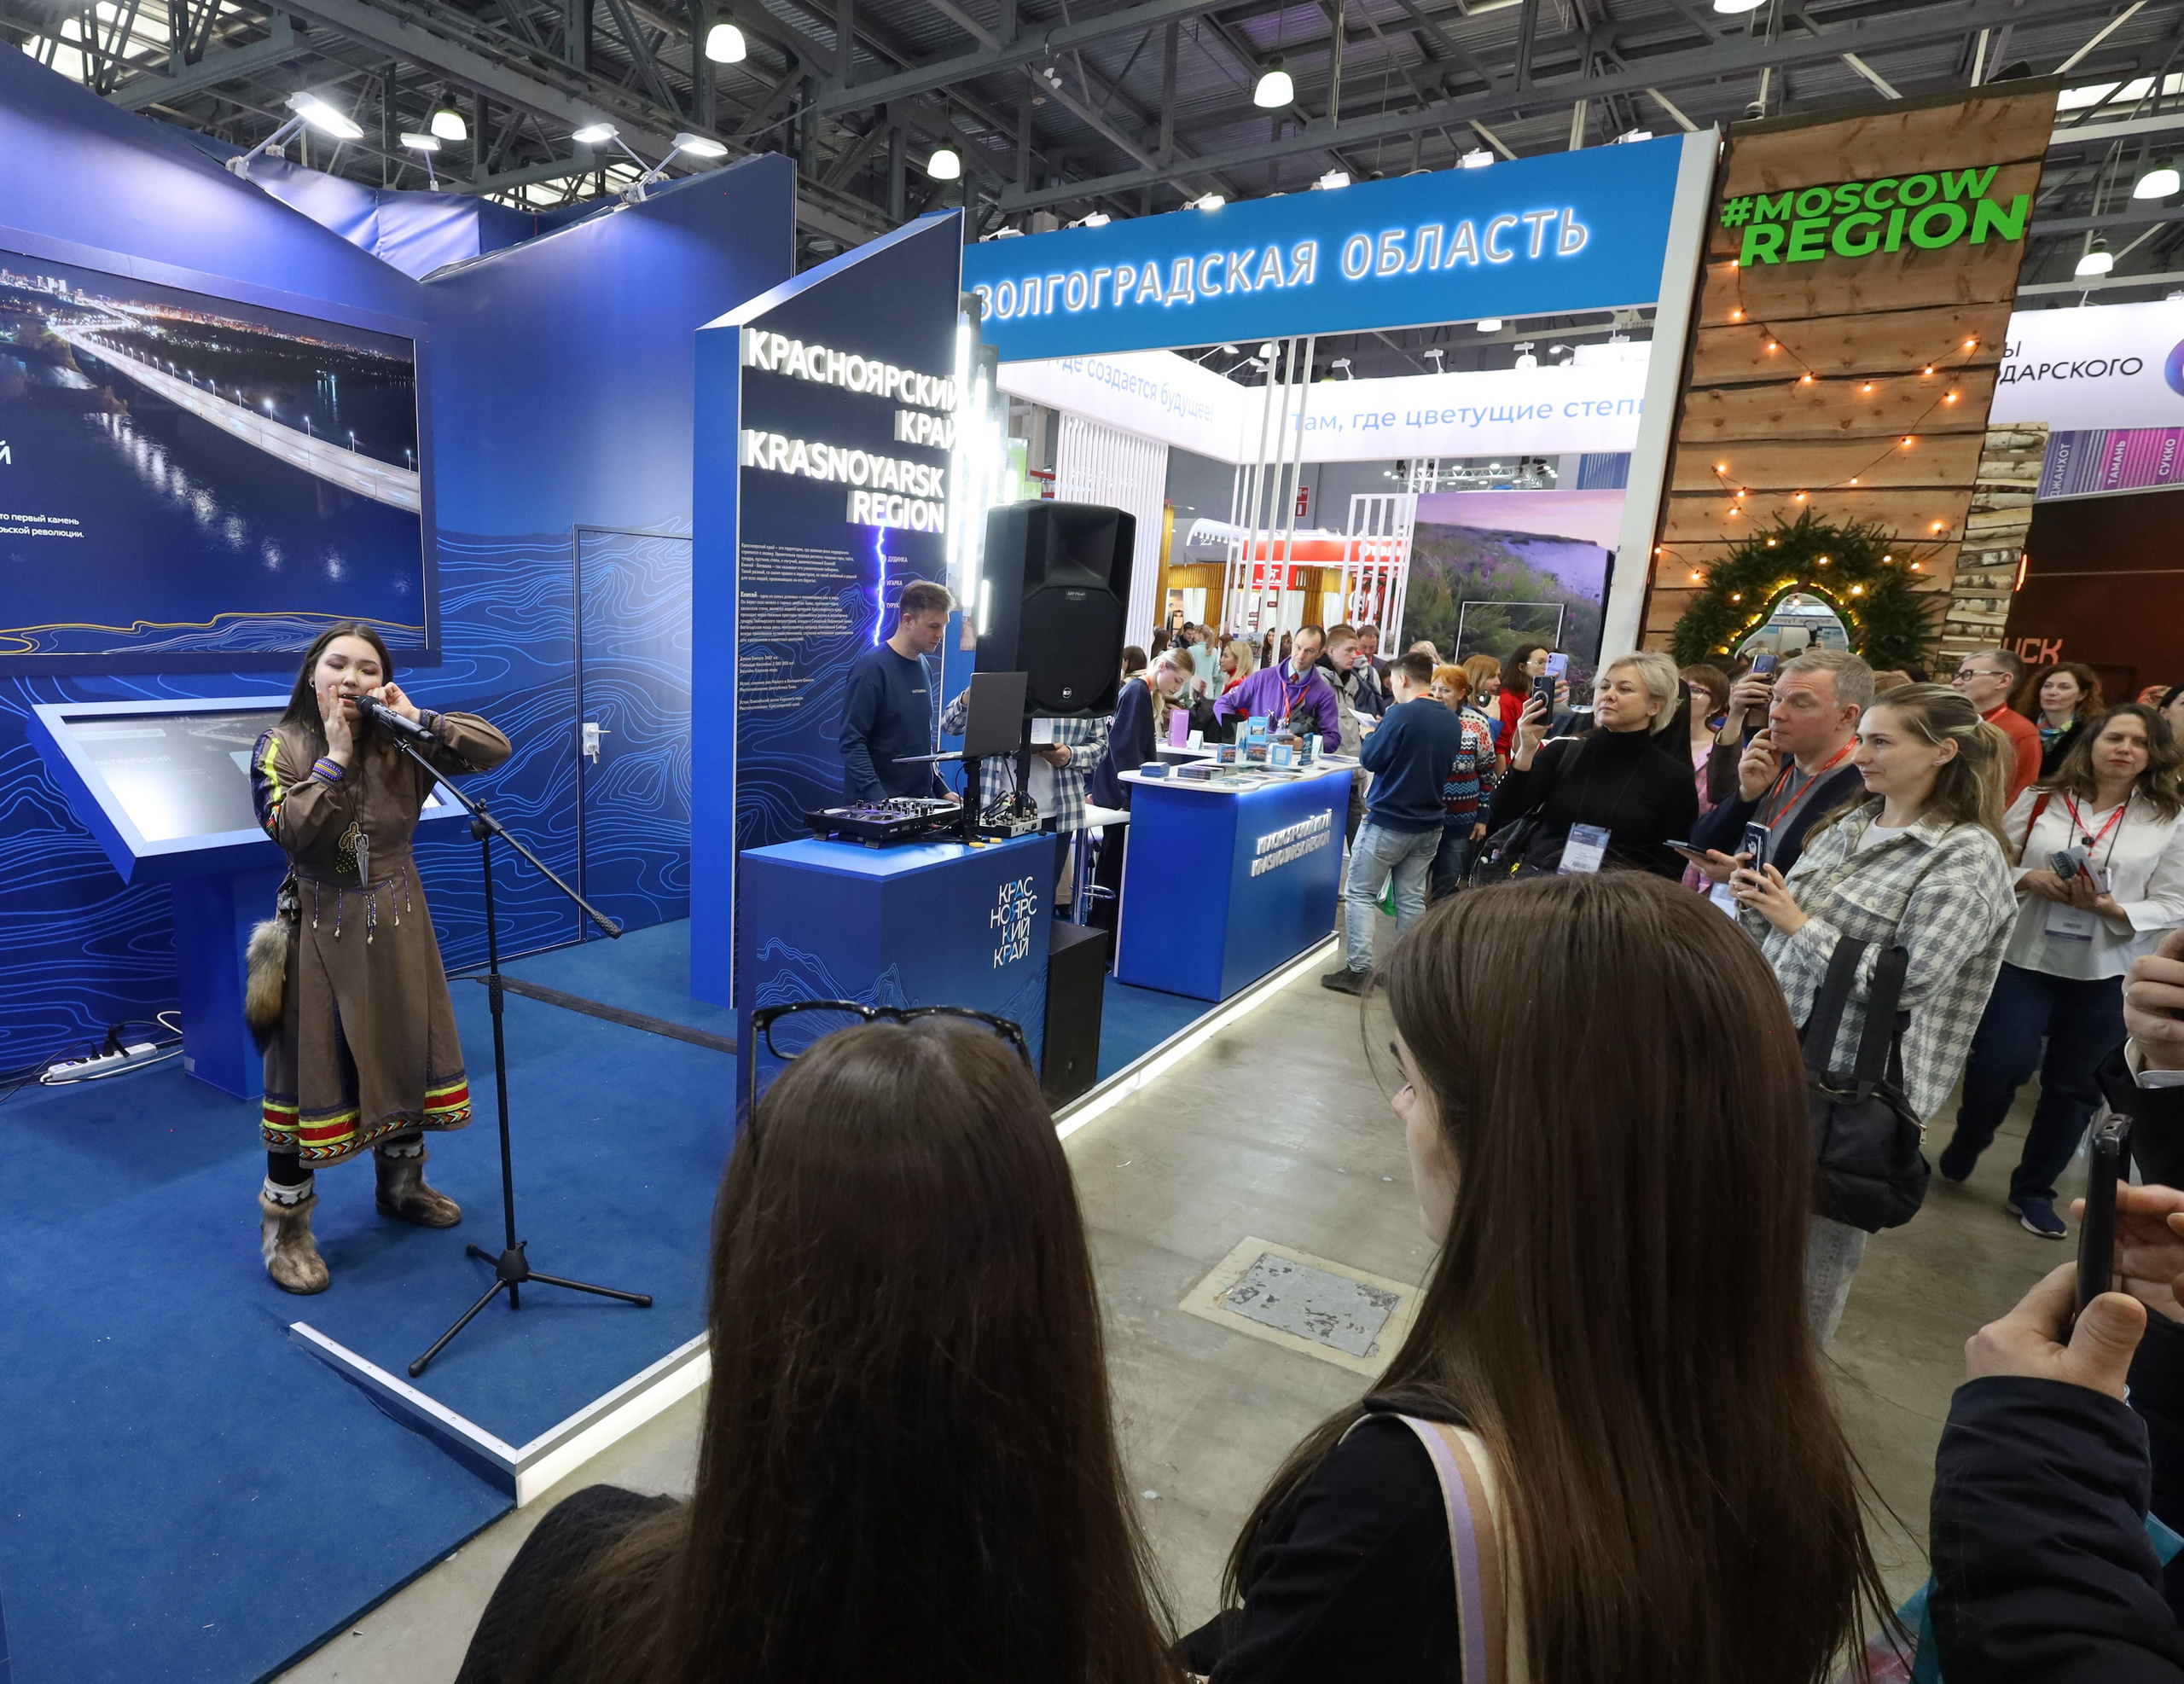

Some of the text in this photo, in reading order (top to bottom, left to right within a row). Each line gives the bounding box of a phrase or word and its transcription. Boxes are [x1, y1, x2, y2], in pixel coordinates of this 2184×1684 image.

[1720, 165, 2000, 228] #MOSCOW
[1342, 208, 1589, 281] ОБЛАСТЬ
[1738, 194, 2030, 266] REGION
[1999, 357, 2143, 385] ДАРСКОГО
[1088, 358, 1158, 402] создается
[1160, 382, 1215, 423] будущее!
[1352, 411, 1397, 431] где
[1405, 404, 1554, 428] цветущие
[741, 429, 945, 499] KRASNOYARSK
[2050, 443, 2071, 496] ДЖАНХОТ
[2107, 440, 2126, 485] ТАМАНЬ
[2159, 438, 2176, 476] СУККО
[11, 514, 46, 523] первый
[48, 516, 80, 526] камень
[846, 490, 945, 534] REGION
[32, 528, 84, 538] революции.
[95, 755, 171, 766] ОКТЯБРЬСКИЙ
[998, 876, 1033, 906] КРАС
[1002, 916, 1031, 945] КИЙ
[993, 936, 1030, 969] КРАЙ
